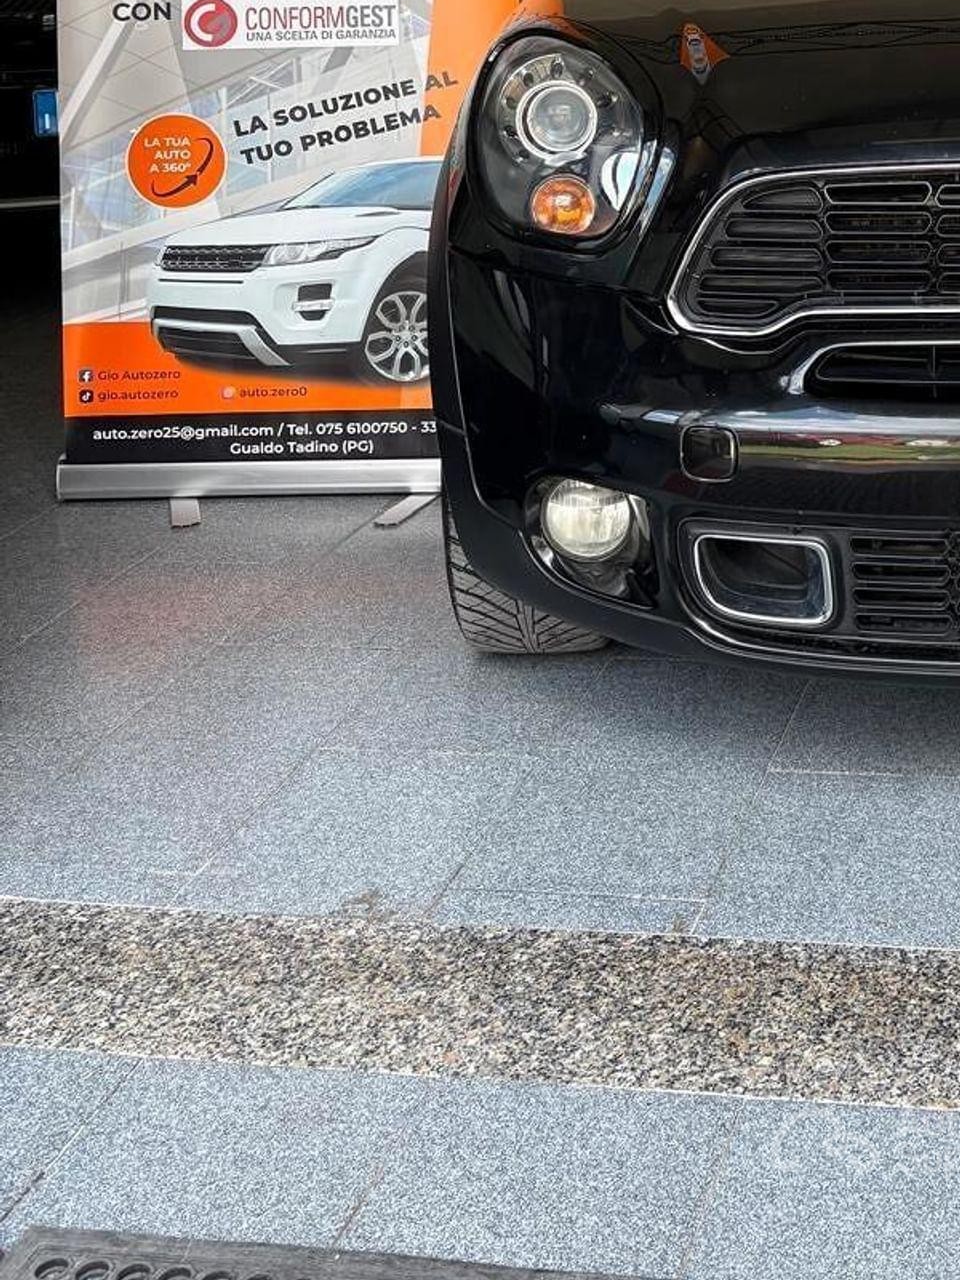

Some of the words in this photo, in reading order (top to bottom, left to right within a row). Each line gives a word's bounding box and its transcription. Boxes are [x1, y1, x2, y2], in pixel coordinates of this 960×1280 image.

[112, 2, 171, 22] CON
[245, 5, 396, 30] CONFORMGEST
[246, 32, 272, 42] UNA
[275, 31, 317, 41] SCELTA
[321, 31, 333, 40] DI
[336, 29, 396, 40] GARANZIA
[233, 116, 267, 138] LA
[273, 79, 416, 126] SOLUZIONE
[424, 70, 458, 92] AL
[144, 137, 160, 147] LA
[164, 137, 191, 147] TUA
[240, 140, 292, 165] TUO
[300, 105, 441, 154] PROBLEMA
[154, 150, 191, 160] AUTO
[150, 163, 159, 173] A
[98, 370, 118, 381] Gio
[122, 370, 181, 380] Autozero
[98, 389, 179, 402] gio.autozero
[93, 424, 273, 440] auto.zero25@gmail.com
[287, 423, 312, 436] Tel.
[316, 423, 343, 436] 075
[347, 422, 407, 435] 6100750
[230, 442, 284, 455] Gualdo
[287, 441, 338, 454] Tadino
[342, 440, 374, 455] (PG)
